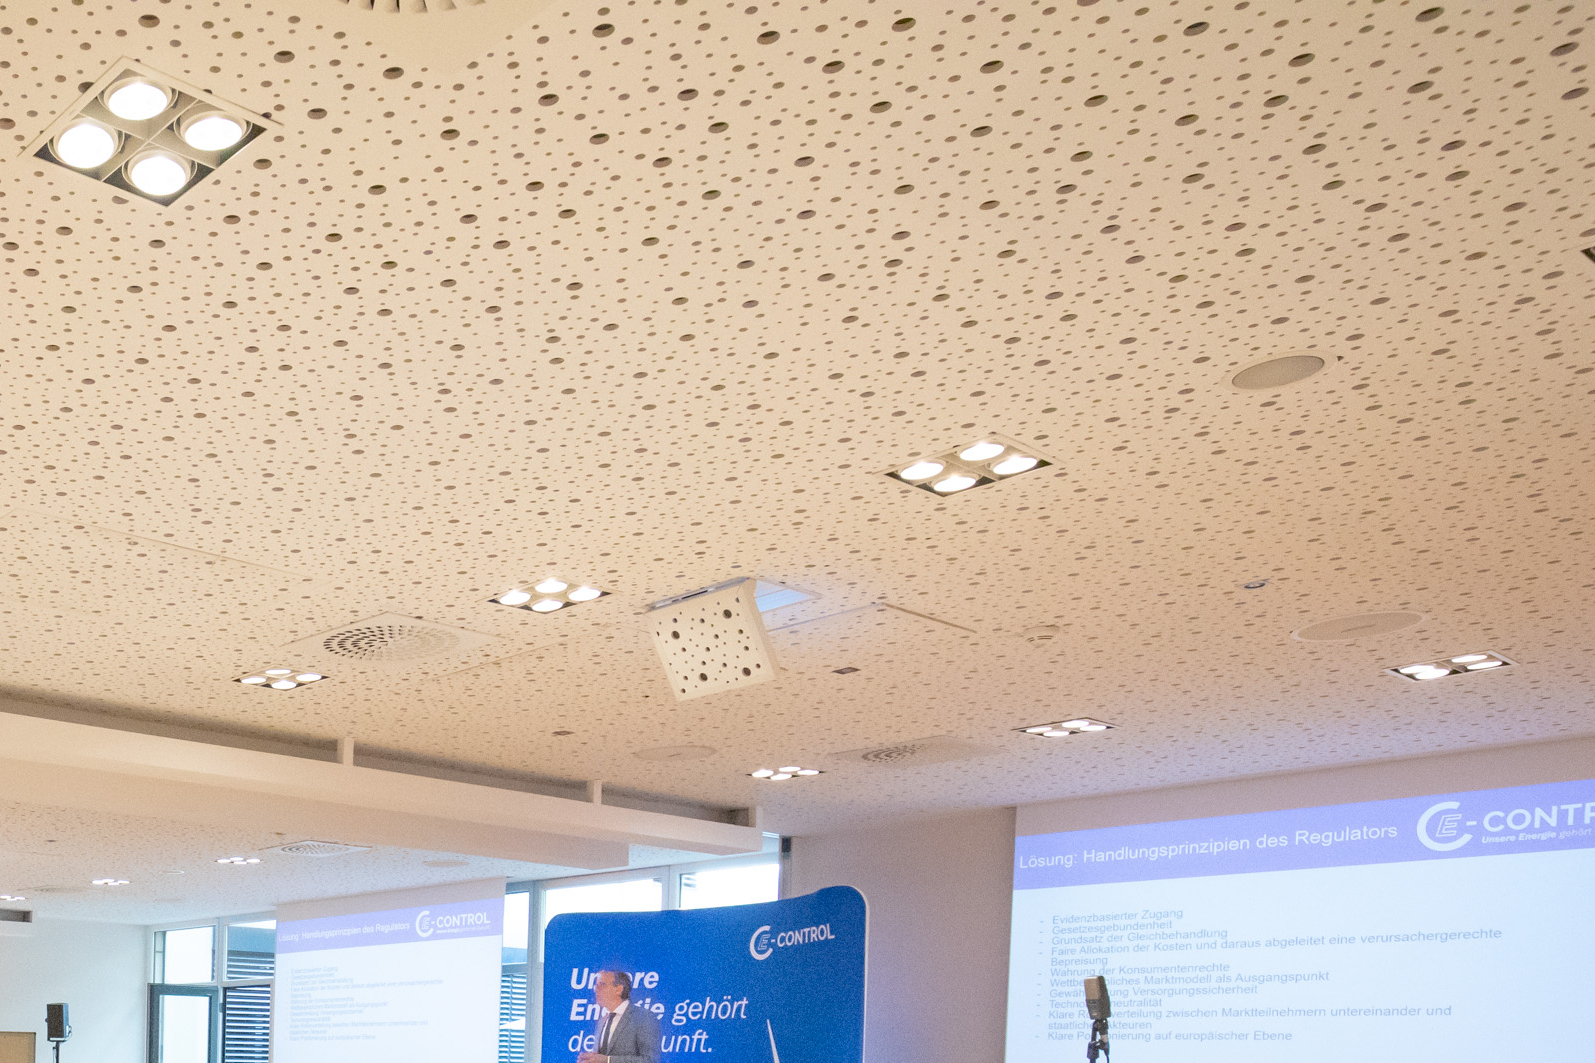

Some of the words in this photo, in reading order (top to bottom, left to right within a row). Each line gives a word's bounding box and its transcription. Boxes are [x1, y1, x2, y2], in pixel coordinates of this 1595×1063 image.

[1518, 830, 1557, 841] Energie
[1019, 853, 1078, 869] Lösung:
[1083, 838, 1250, 863] Handlungsprinzipien
[1256, 833, 1288, 849] des
[1294, 826, 1398, 847] Regulators
[1052, 912, 1138, 925] Evidenzbasierter
[1141, 909, 1184, 920] Zugang
[1052, 920, 1173, 936] Gesetzesgebundenheit
[1051, 934, 1103, 946] Grundsatz
[1107, 932, 1124, 943] der
[1127, 928, 1228, 943] Gleichbehandlung
[1051, 945, 1077, 956] Faire
[1079, 943, 1131, 955] Allokation
[1132, 942, 1150, 953] der
[1153, 940, 1193, 952] Kosten
[1196, 939, 1217, 950] und
[1221, 938, 1262, 949] daraus
[1264, 935, 1325, 949] abgeleitet
[1328, 934, 1357, 945] eine
[1360, 928, 1503, 944] verursachergerechte
[1051, 956, 1108, 968] Bepreisung
[1050, 967, 1096, 978] Wahrung
[1098, 964, 1116, 975] der
[1118, 963, 1231, 975] Konsumentenrechte
[1144, 974, 1212, 985] Marktmodell
[1215, 974, 1232, 984] als
[1235, 971, 1330, 985] Ausgangspunkt
[1132, 985, 1258, 997] Versorgungssicherheit
[671, 995, 749, 1026] gehört
[1048, 1010, 1075, 1019] Klare
[1165, 1008, 1218, 1018] zwischen
[1221, 1007, 1326, 1017] Marktteilnehmern
[1330, 1005, 1422, 1017] untereinander
[1426, 1005, 1452, 1016] und
[568, 1030, 595, 1052] de
[1047, 1031, 1074, 1040] Klare
[1154, 1030, 1173, 1041] auf
[1175, 1030, 1250, 1042] europäischer
[1253, 1030, 1293, 1041] Ebene
